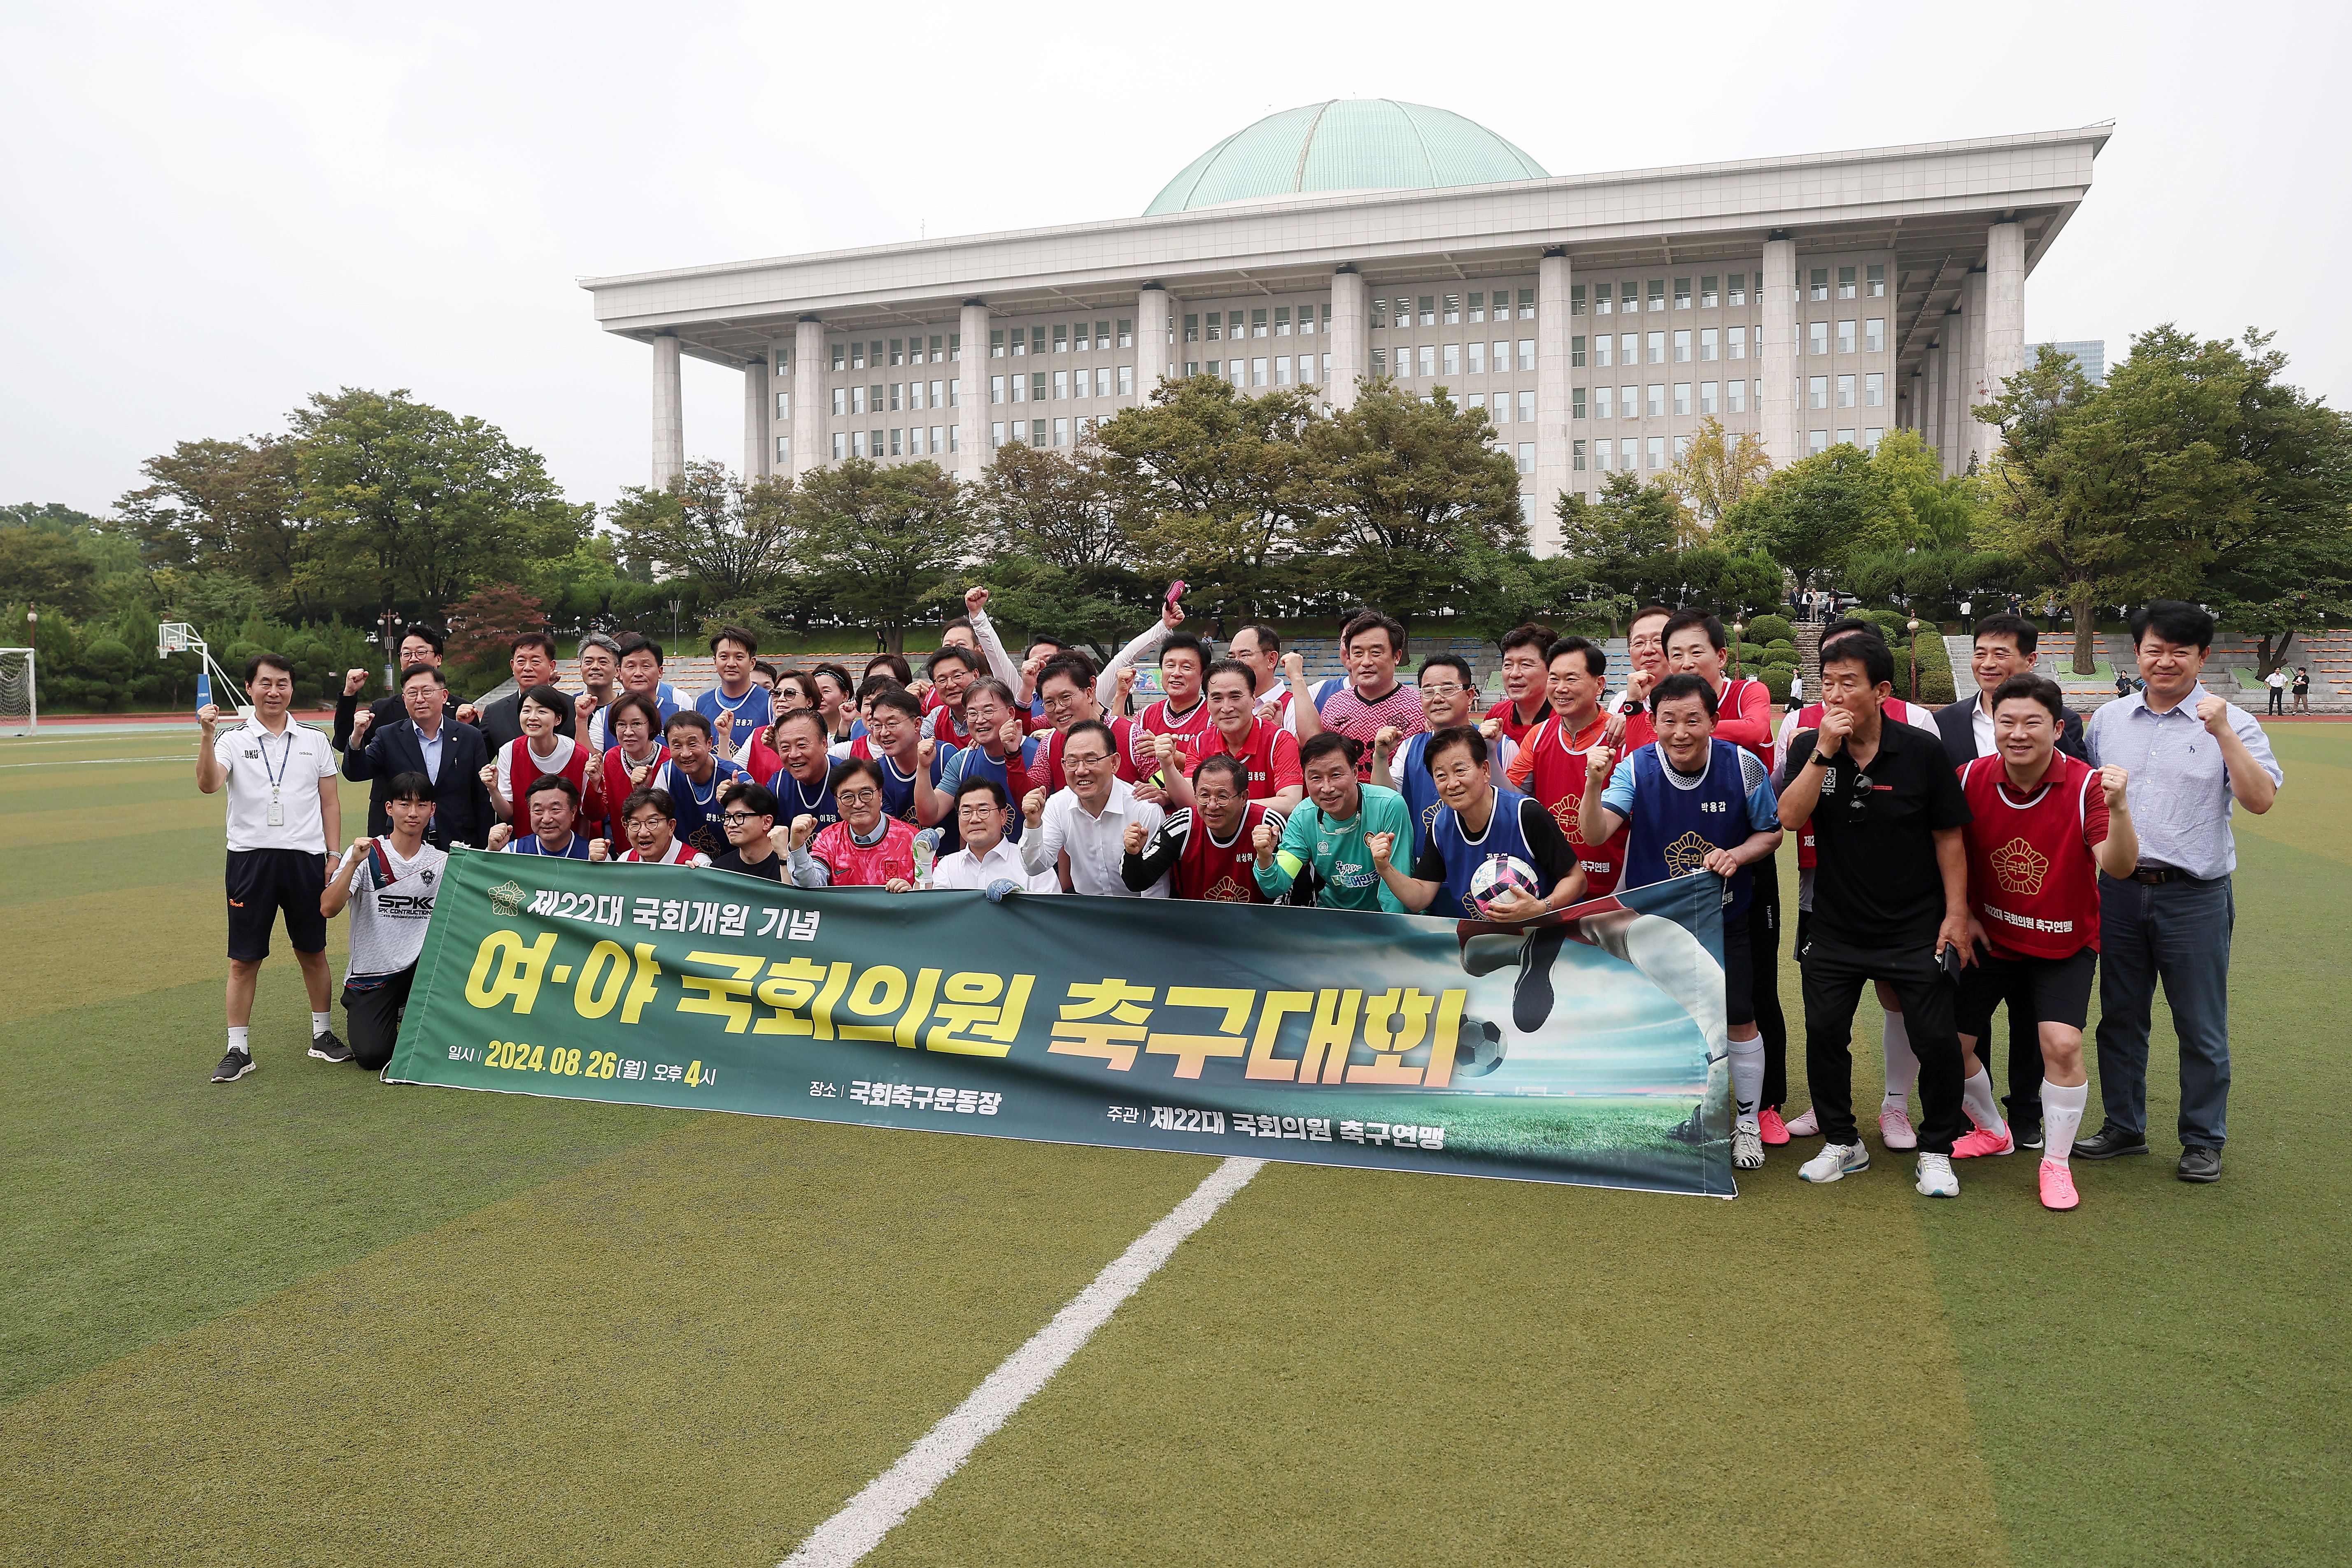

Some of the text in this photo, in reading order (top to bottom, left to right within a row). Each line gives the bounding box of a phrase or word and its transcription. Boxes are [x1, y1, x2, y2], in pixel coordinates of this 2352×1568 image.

[735, 719, 753, 727] 전용기
[245, 749, 259, 759] DKU
[1248, 772, 1266, 781] 김종양
[1701, 801, 1726, 812] 박용갑
[1236, 853, 1253, 862] 이상휘
[1679, 853, 1702, 867] 국회
[1581, 861, 1610, 873] 축구연맹
[2007, 861, 2030, 876] 국회
[527, 889, 821, 942] 제22대 국회개원 기념
[1984, 903, 2073, 933] 제22대 국회의원 축구연맹
[675, 950, 1036, 1058] 국회의원
[1046, 977, 1467, 1088] 축구대회
[448, 1045, 474, 1063] 일시
[809, 1080, 1003, 1116] 장소 국회축구운동장
[1107, 1105, 1446, 1151] 주관 제22대 국회의원 축구연맹
